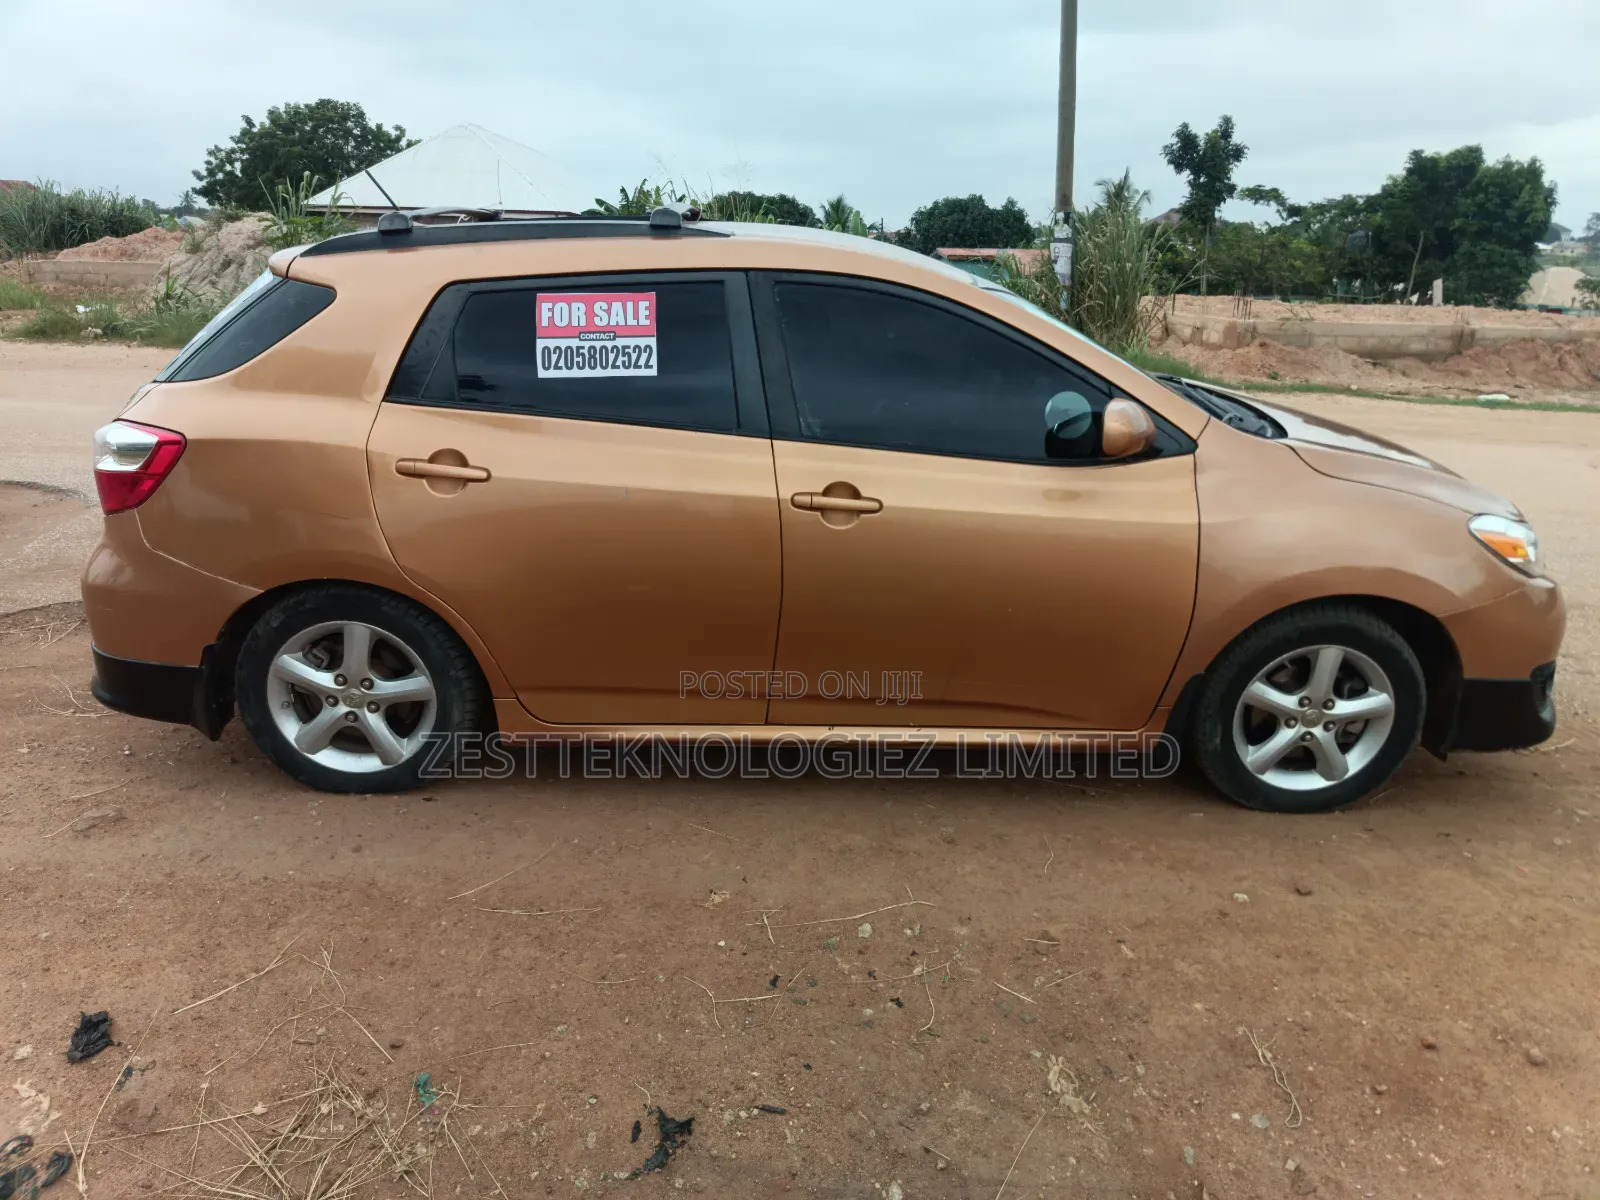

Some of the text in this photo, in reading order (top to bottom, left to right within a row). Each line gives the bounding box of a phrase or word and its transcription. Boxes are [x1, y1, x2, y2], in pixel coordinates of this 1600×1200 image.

[541, 300, 651, 326] FOR SALE
[541, 344, 653, 371] 0205802522
